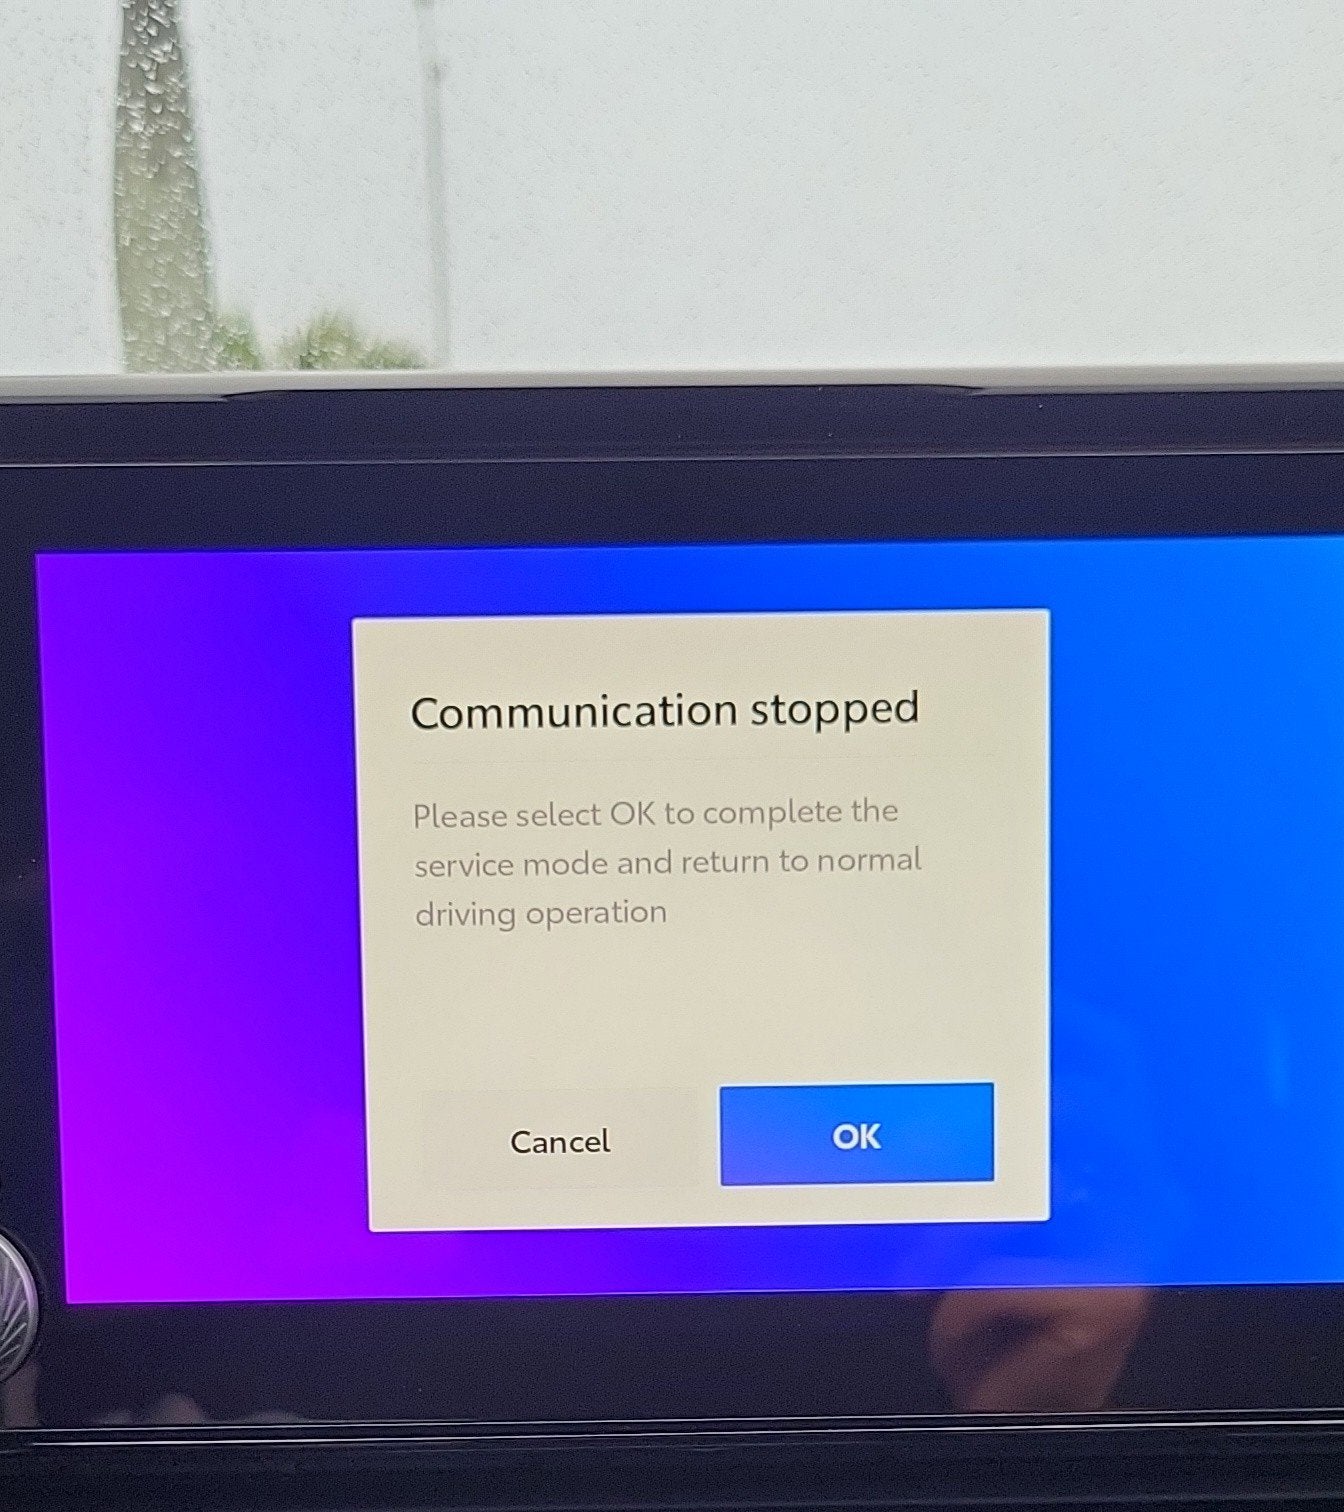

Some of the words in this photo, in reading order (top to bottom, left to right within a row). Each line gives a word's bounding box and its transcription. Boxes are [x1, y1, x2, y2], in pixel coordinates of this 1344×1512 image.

[411, 692, 738, 730] Communication
[750, 689, 920, 733] stopped
[414, 802, 508, 830] Please
[516, 801, 602, 828] select
[610, 800, 657, 827] OK
[664, 801, 696, 826] to
[703, 798, 843, 831] complete
[851, 797, 899, 824] the
[414, 851, 515, 878] service
[523, 849, 609, 876] mode
[617, 848, 673, 875] and
[682, 849, 770, 874] return
[779, 848, 810, 873] to
[817, 845, 923, 873] normal
[415, 901, 517, 932] driving
[526, 899, 668, 931] operation
[509, 1127, 612, 1155] Cancel
[832, 1122, 882, 1151] OK
